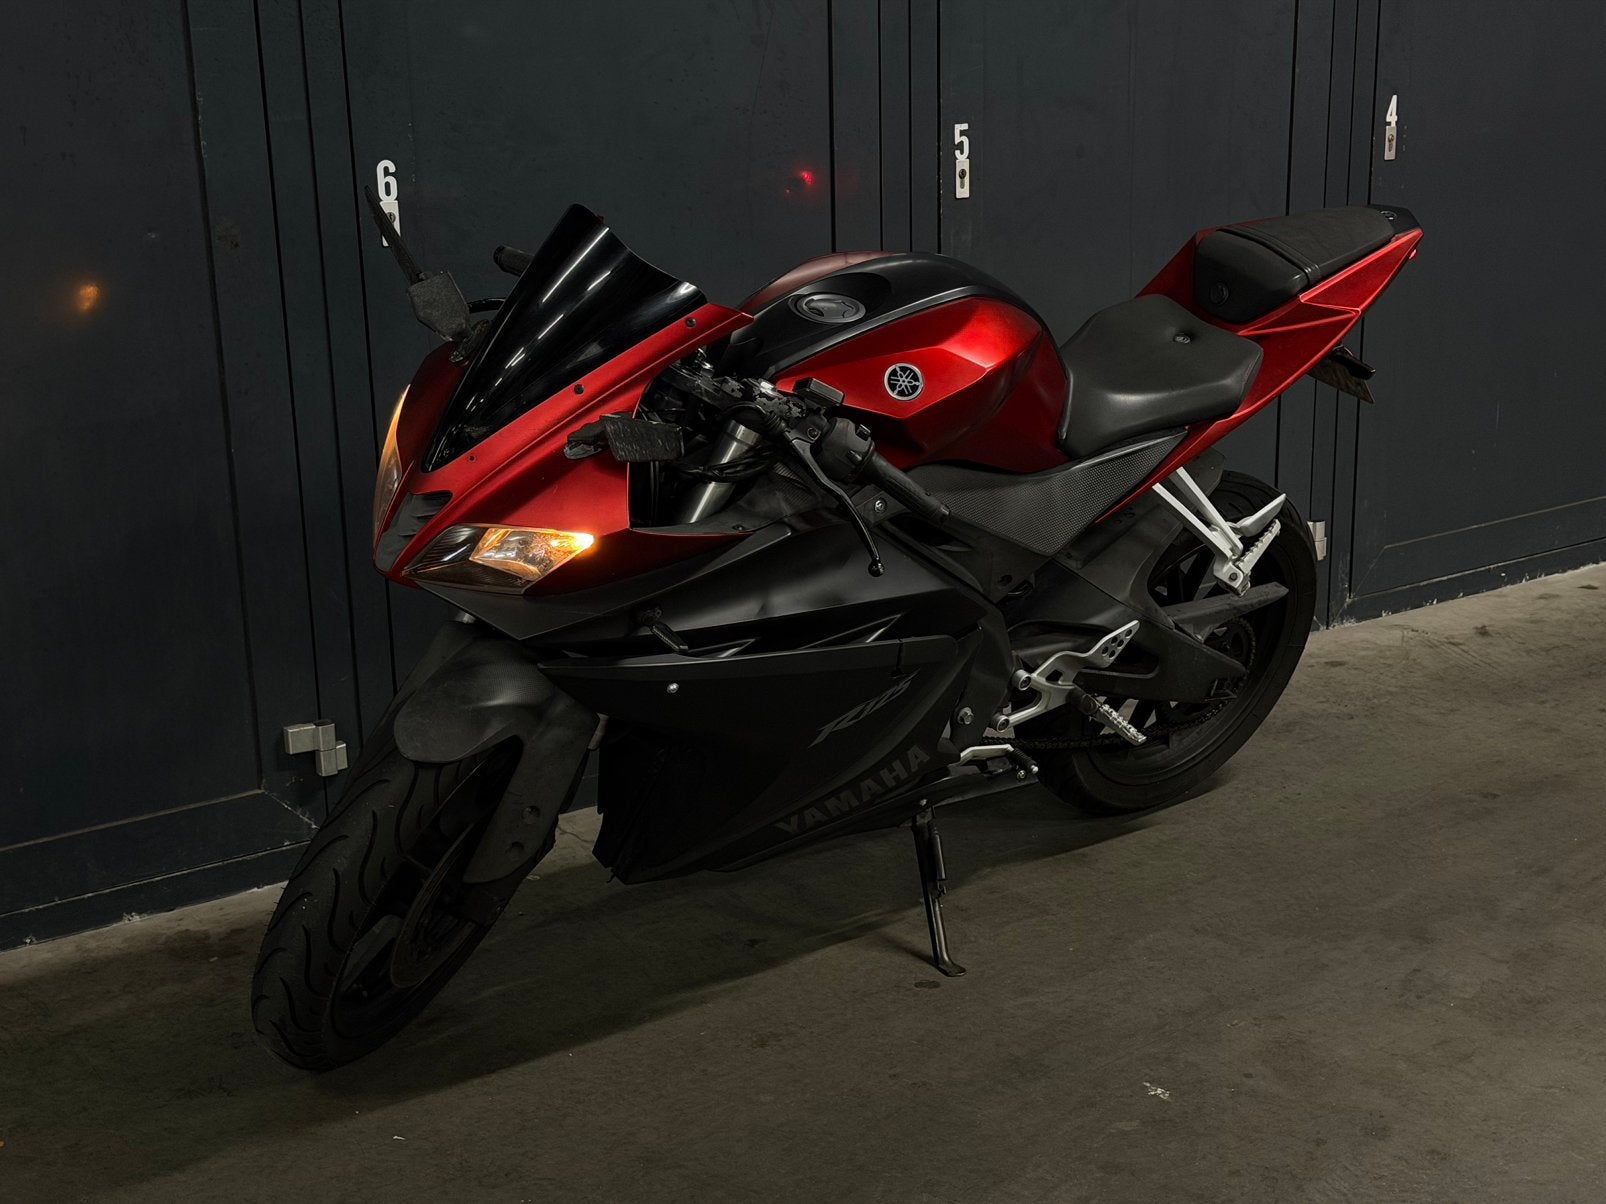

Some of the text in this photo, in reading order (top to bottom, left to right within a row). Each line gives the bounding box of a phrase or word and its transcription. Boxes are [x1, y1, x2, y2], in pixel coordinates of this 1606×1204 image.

[1385, 94, 1398, 127] 4
[954, 123, 969, 160] 5
[376, 159, 398, 201] 6
[774, 744, 931, 834] YAMAHA
